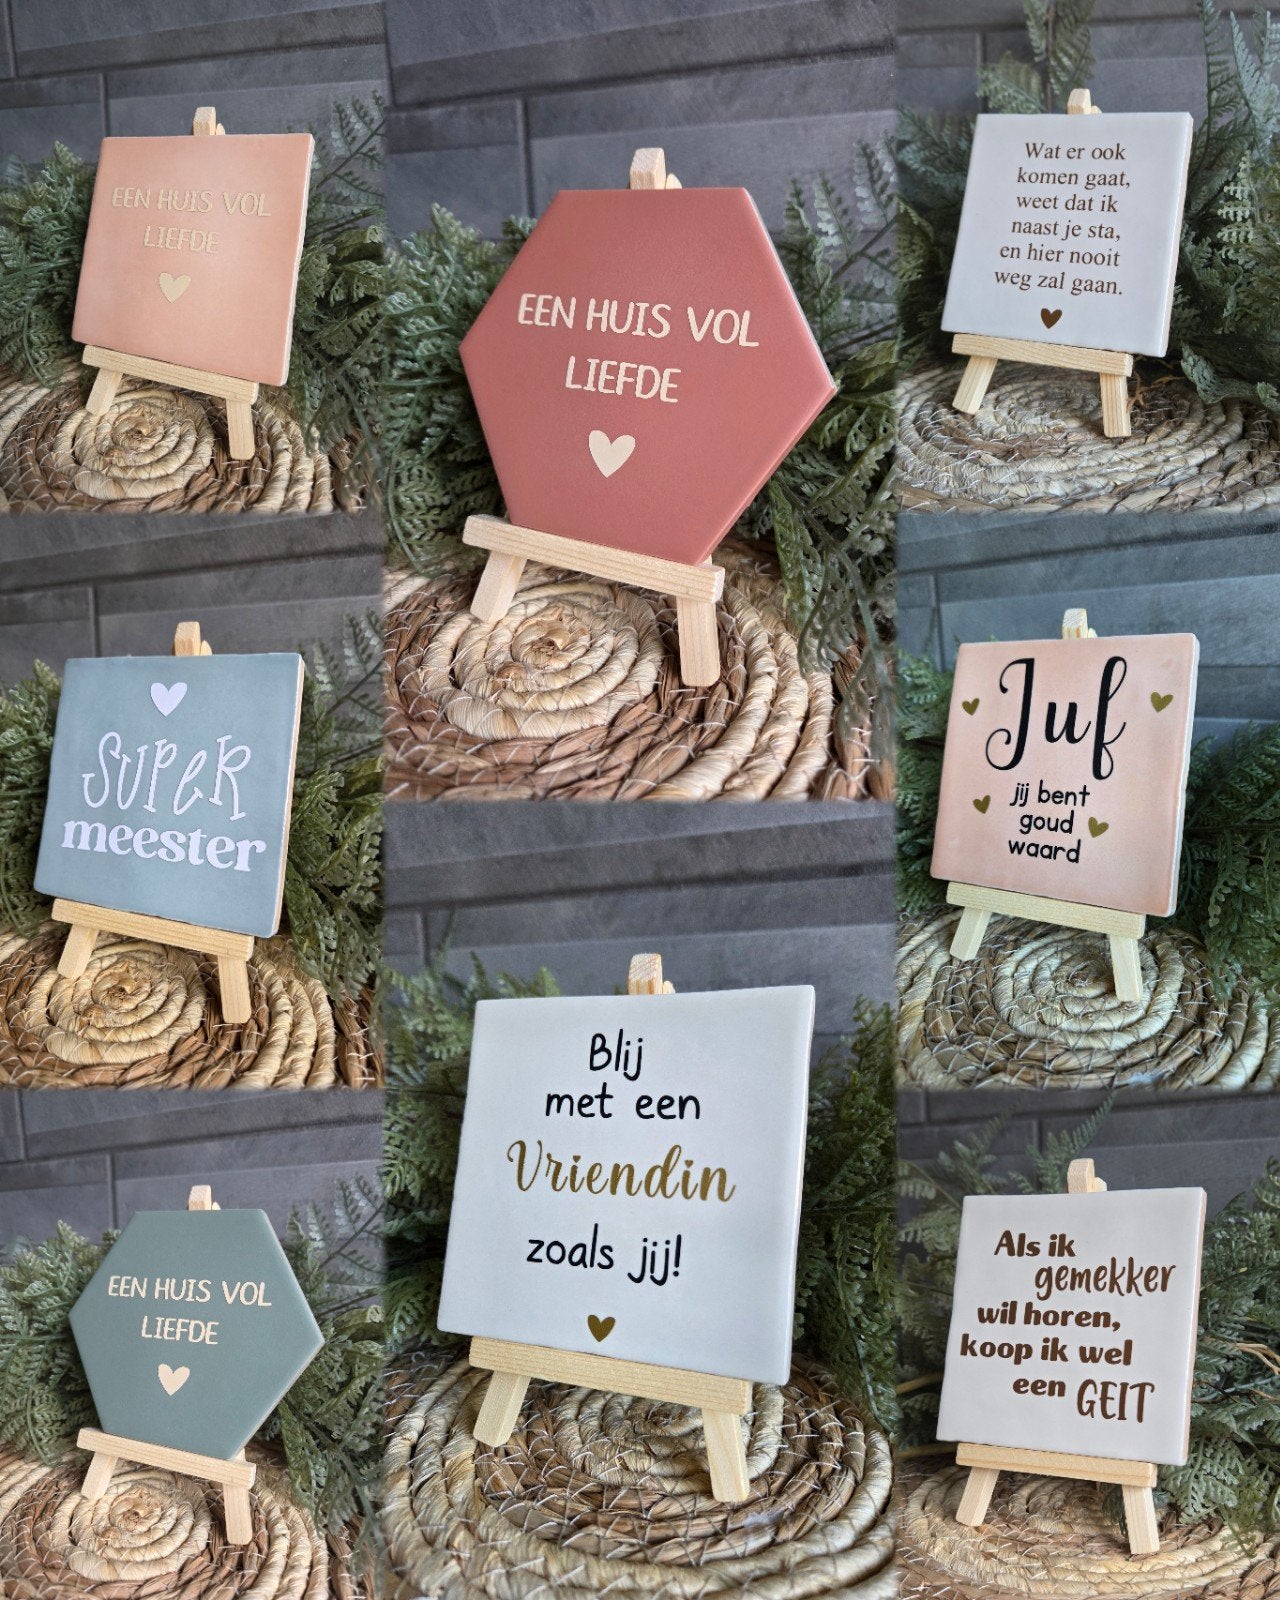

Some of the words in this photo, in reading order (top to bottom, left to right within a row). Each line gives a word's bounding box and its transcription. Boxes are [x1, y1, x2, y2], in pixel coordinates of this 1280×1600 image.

[1025, 142, 1061, 159] Wat
[1067, 146, 1085, 160] er
[1091, 143, 1126, 160] ook
[1017, 167, 1078, 185] komen
[1084, 171, 1131, 190] gaat,
[112, 187, 151, 209] EEN
[157, 190, 213, 213] HUIS
[223, 192, 271, 216] VOL
[1017, 196, 1058, 209] weet
[1065, 194, 1094, 212] dat
[1100, 195, 1118, 213] ik
[144, 224, 221, 253] LIEFDE
[1011, 220, 1058, 235] naast
[1062, 220, 1082, 240] je
[1088, 224, 1121, 241] sta,
[1000, 245, 1021, 259] en
[1027, 243, 1064, 262] hier
[1069, 248, 1121, 266] nooit
[994, 271, 1032, 290] weg
[1037, 272, 1065, 289] zal
[1071, 278, 1123, 295] gaan.
[518, 294, 576, 329] EEN
[587, 299, 672, 338] HUIS
[687, 307, 759, 347] VOL
[565, 356, 682, 403] LIEFDE
[985, 656, 1127, 780] Juf
[1009, 783, 1030, 807] jij
[1038, 779, 1090, 807] bent
[1020, 810, 1074, 835] goud
[61, 820, 267, 872] meester
[1008, 839, 1081, 863] waard
[589, 1029, 644, 1082] Blij
[546, 1082, 613, 1118] met
[635, 1093, 701, 1119] een
[507, 1139, 736, 1202] Vriendin
[526, 1223, 614, 1270] zoals
[628, 1234, 682, 1286] jij!
[994, 1230, 1040, 1257] Als
[1048, 1233, 1076, 1257] ik
[108, 1275, 148, 1298] EEN
[154, 1278, 211, 1302] HUIS
[221, 1280, 272, 1306] VOL
[1034, 1256, 1176, 1301] gemekker
[141, 1316, 219, 1345] LIEFDE
[977, 1301, 1017, 1324] wil
[1023, 1301, 1121, 1331] horen,
[960, 1333, 1033, 1365] koop
[1040, 1337, 1069, 1362] ik
[1079, 1339, 1133, 1366] wel
[1012, 1378, 1066, 1397] een
[1077, 1379, 1155, 1423] GEIT
